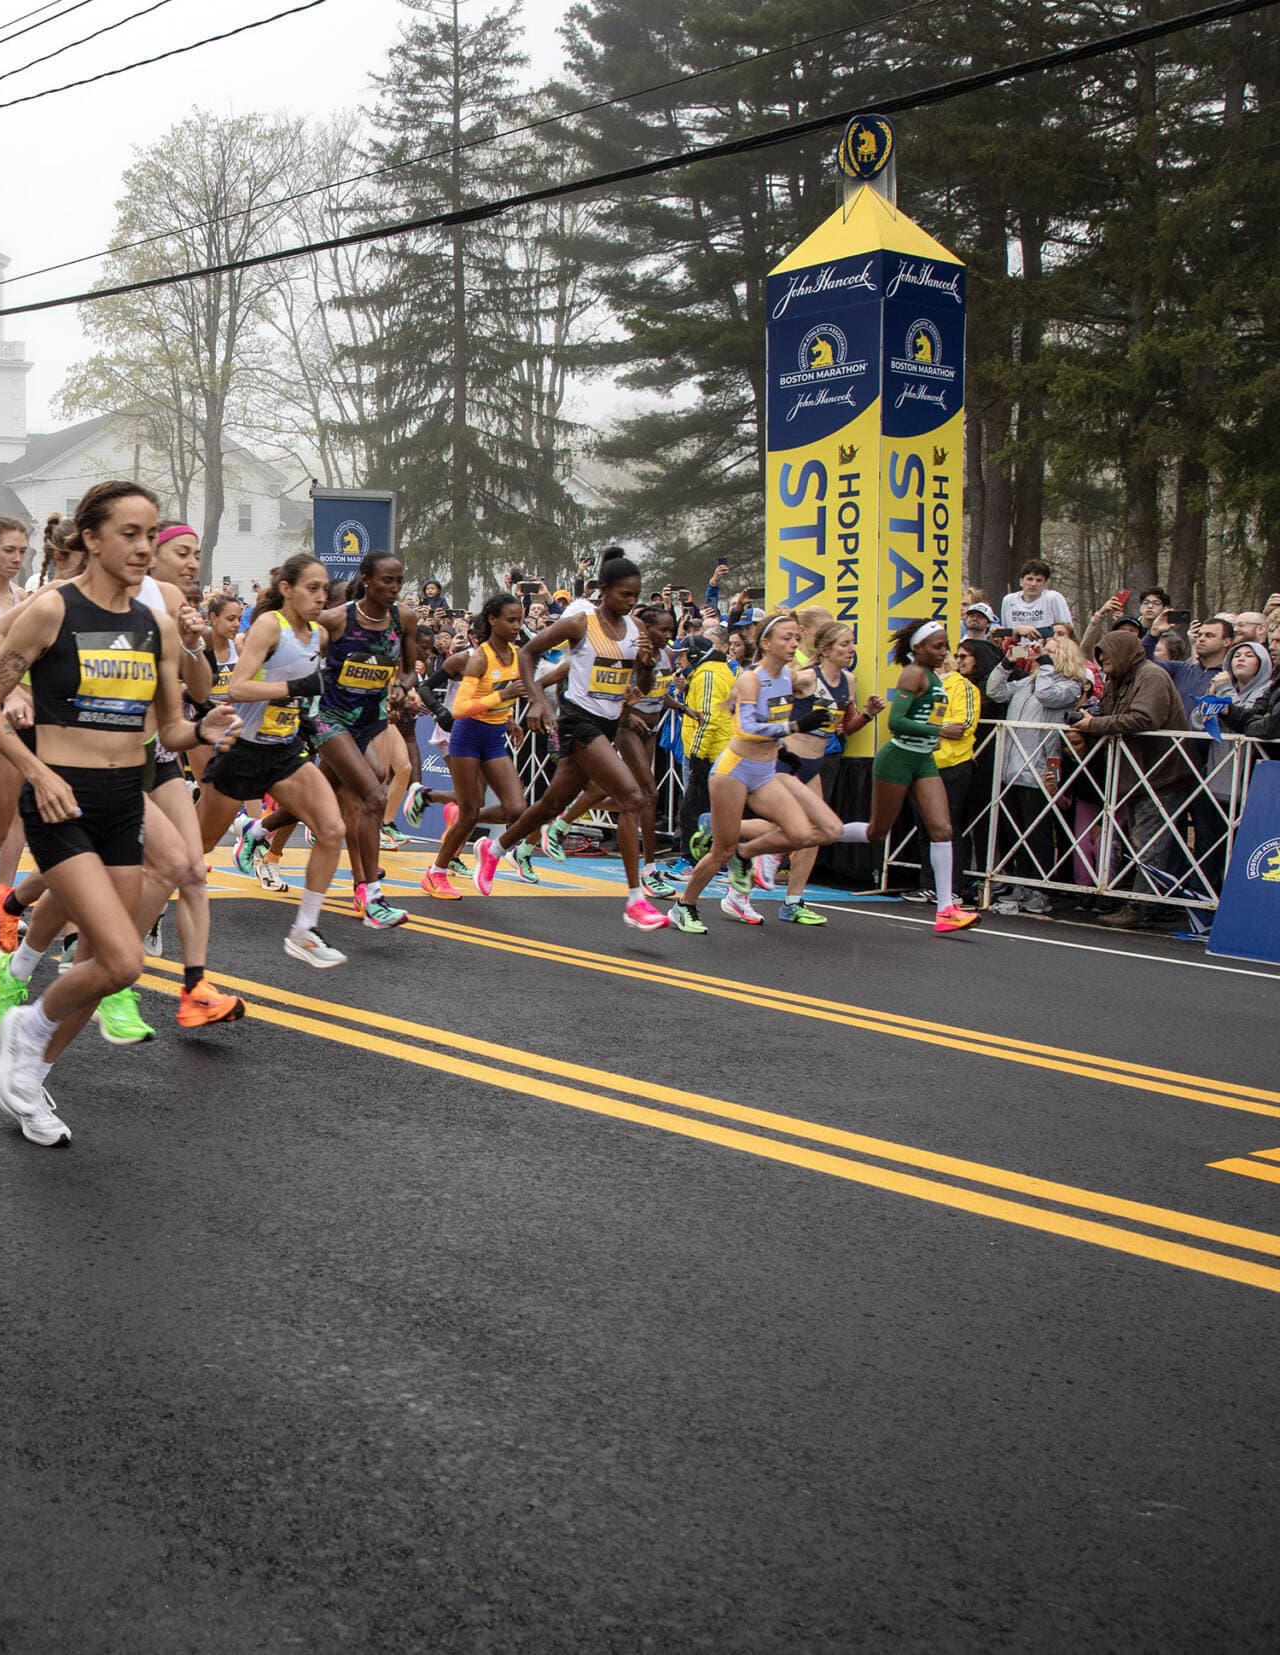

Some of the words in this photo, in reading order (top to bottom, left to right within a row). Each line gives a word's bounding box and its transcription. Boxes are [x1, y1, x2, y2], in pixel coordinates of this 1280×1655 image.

[772, 274, 813, 319] John
[813, 260, 877, 297] Hancock
[886, 259, 918, 297] John
[918, 263, 962, 304] Hancock
[799, 342, 810, 369] BOSTON
[805, 326, 829, 343] ATHLETIC
[828, 327, 846, 362] ASSOCIATION
[780, 373, 814, 386] BOSTON
[816, 363, 867, 378] MARATHON
[891, 360, 918, 373] BOSTON
[919, 364, 954, 378] MARATHON
[786, 393, 814, 422] John
[814, 386, 856, 406] Hancock
[894, 382, 917, 408] John
[917, 383, 947, 411] Hancock
[320, 555, 346, 563] BOSTON
[84, 659, 154, 681] MONTOYA
[345, 665, 389, 681] BERISO
[421, 754, 451, 776] Hanco
[1249, 851, 1263, 877] BOSTON
[1262, 840, 1280, 852] ATHL
